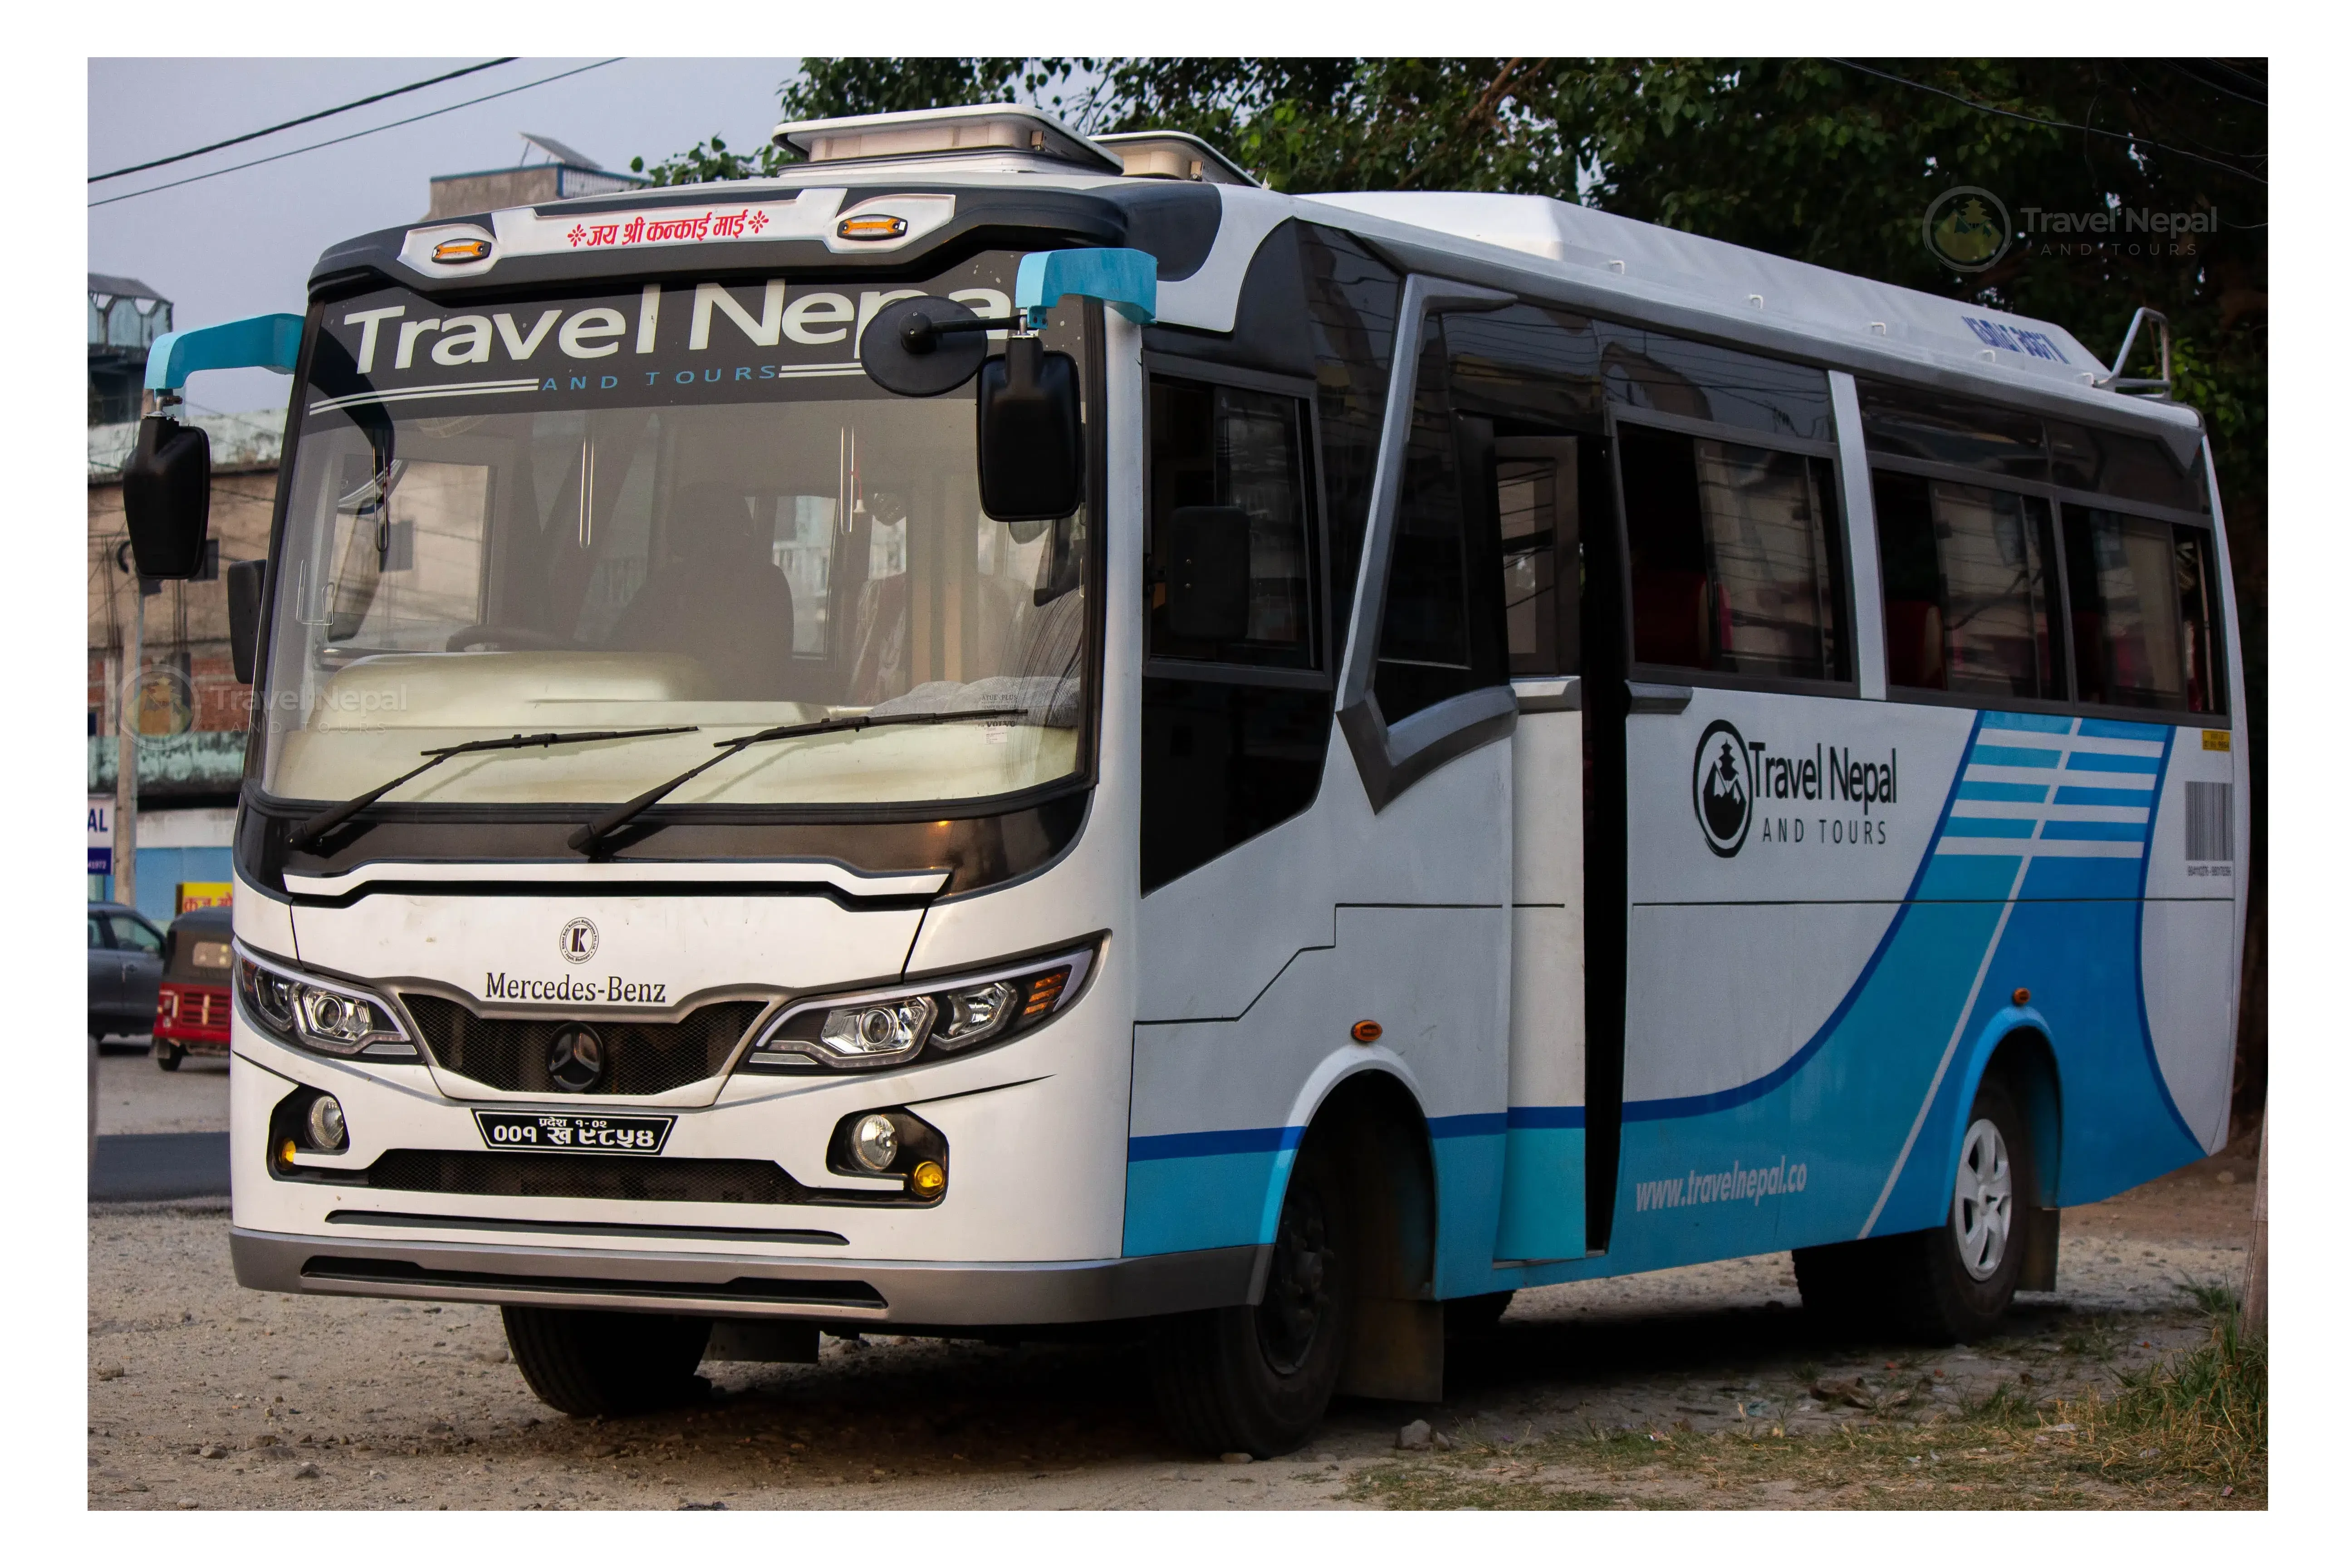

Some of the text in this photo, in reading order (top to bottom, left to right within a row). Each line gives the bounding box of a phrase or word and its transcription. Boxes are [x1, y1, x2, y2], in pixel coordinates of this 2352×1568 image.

[587, 225, 620, 246] जय
[622, 216, 645, 245] श्री
[713, 209, 749, 239] माई
[344, 283, 661, 375] Travel
[542, 365, 776, 391] AND TOURS
[1749, 741, 1897, 815] Travel Nepal
[1762, 818, 1886, 845] AND TOURS
[571, 928, 588, 952] K
[485, 972, 666, 1003] Mercedes-Benz
[539, 1117, 567, 1127] प्रदेश
[1636, 1155, 1808, 1212] www.travelnepal.co
